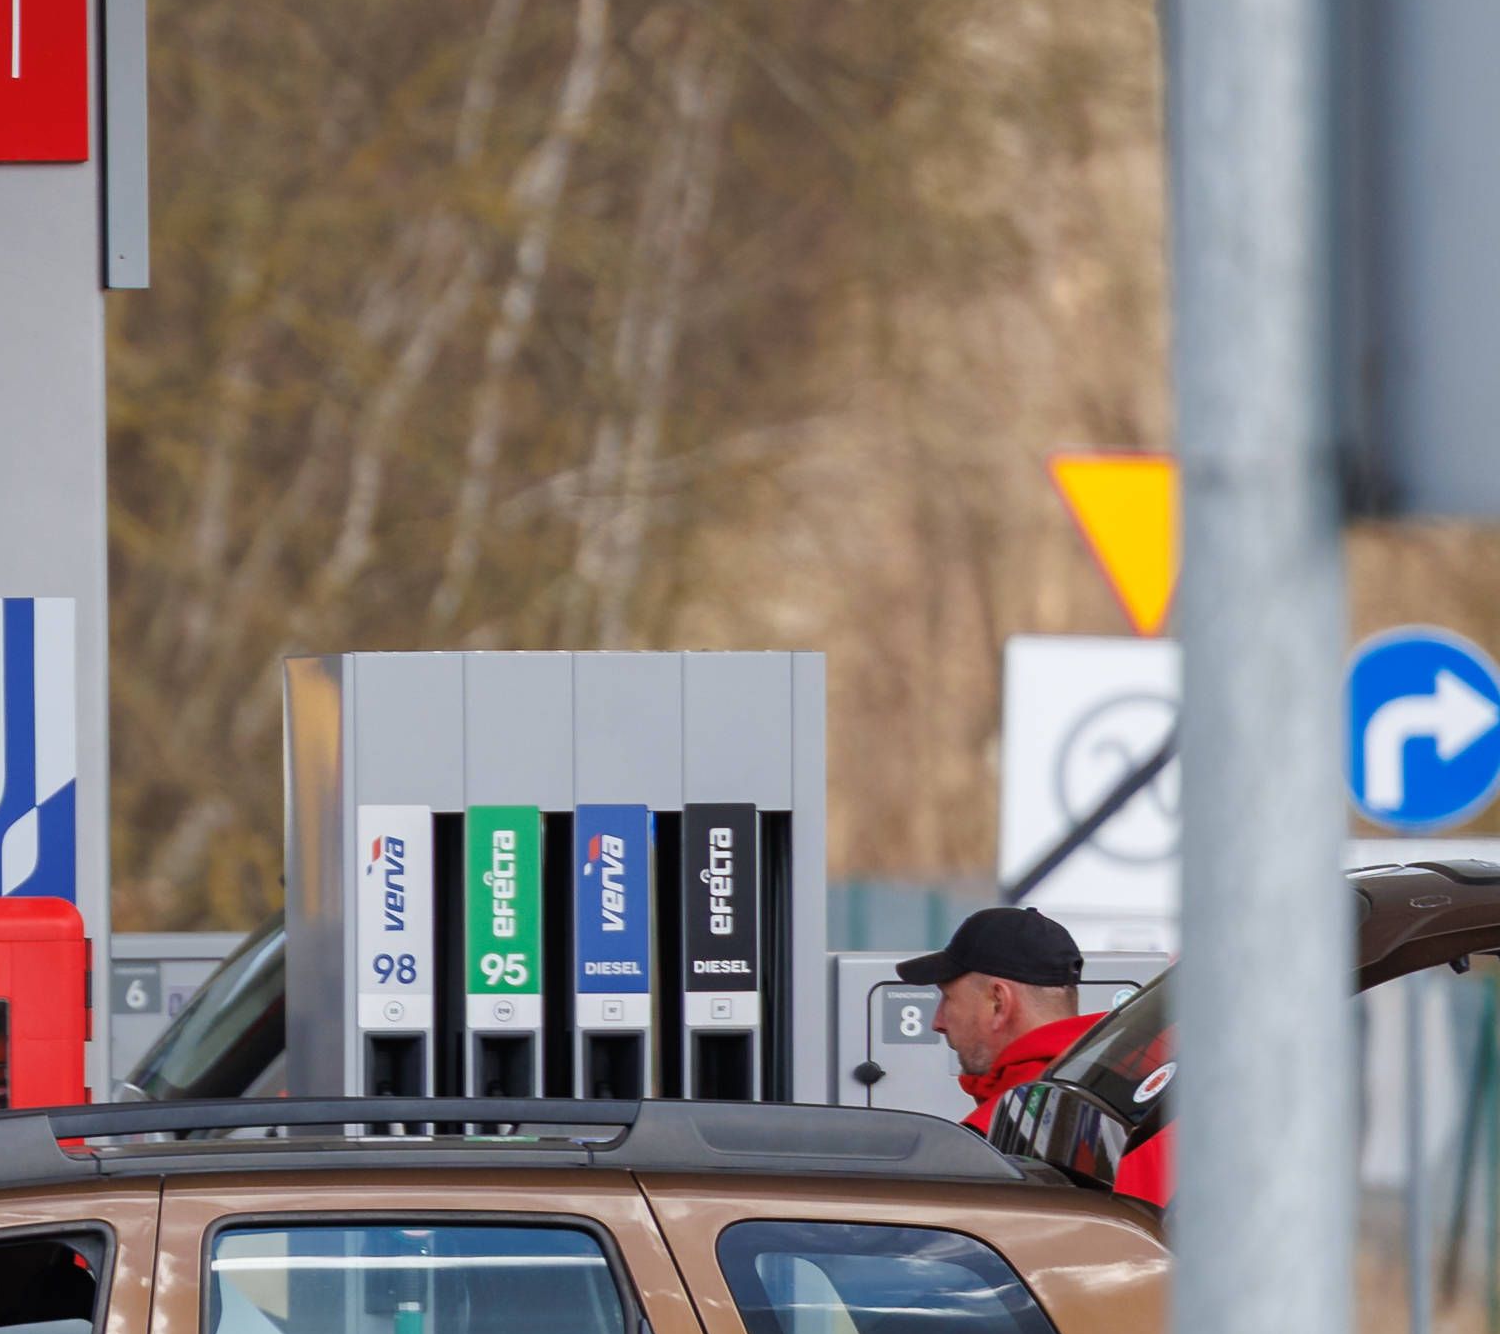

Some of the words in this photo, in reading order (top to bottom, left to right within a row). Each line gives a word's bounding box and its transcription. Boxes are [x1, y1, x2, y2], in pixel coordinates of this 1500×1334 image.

[384, 835, 405, 932] verva
[490, 829, 517, 938] efecta
[601, 833, 626, 932] verva
[706, 827, 734, 935] efecta
[372, 952, 418, 985] 98
[480, 952, 528, 986] 95
[584, 961, 642, 975] DIESEL
[692, 959, 751, 974] DIESEL
[125, 979, 147, 1010] 6
[899, 1004, 922, 1037] 8
